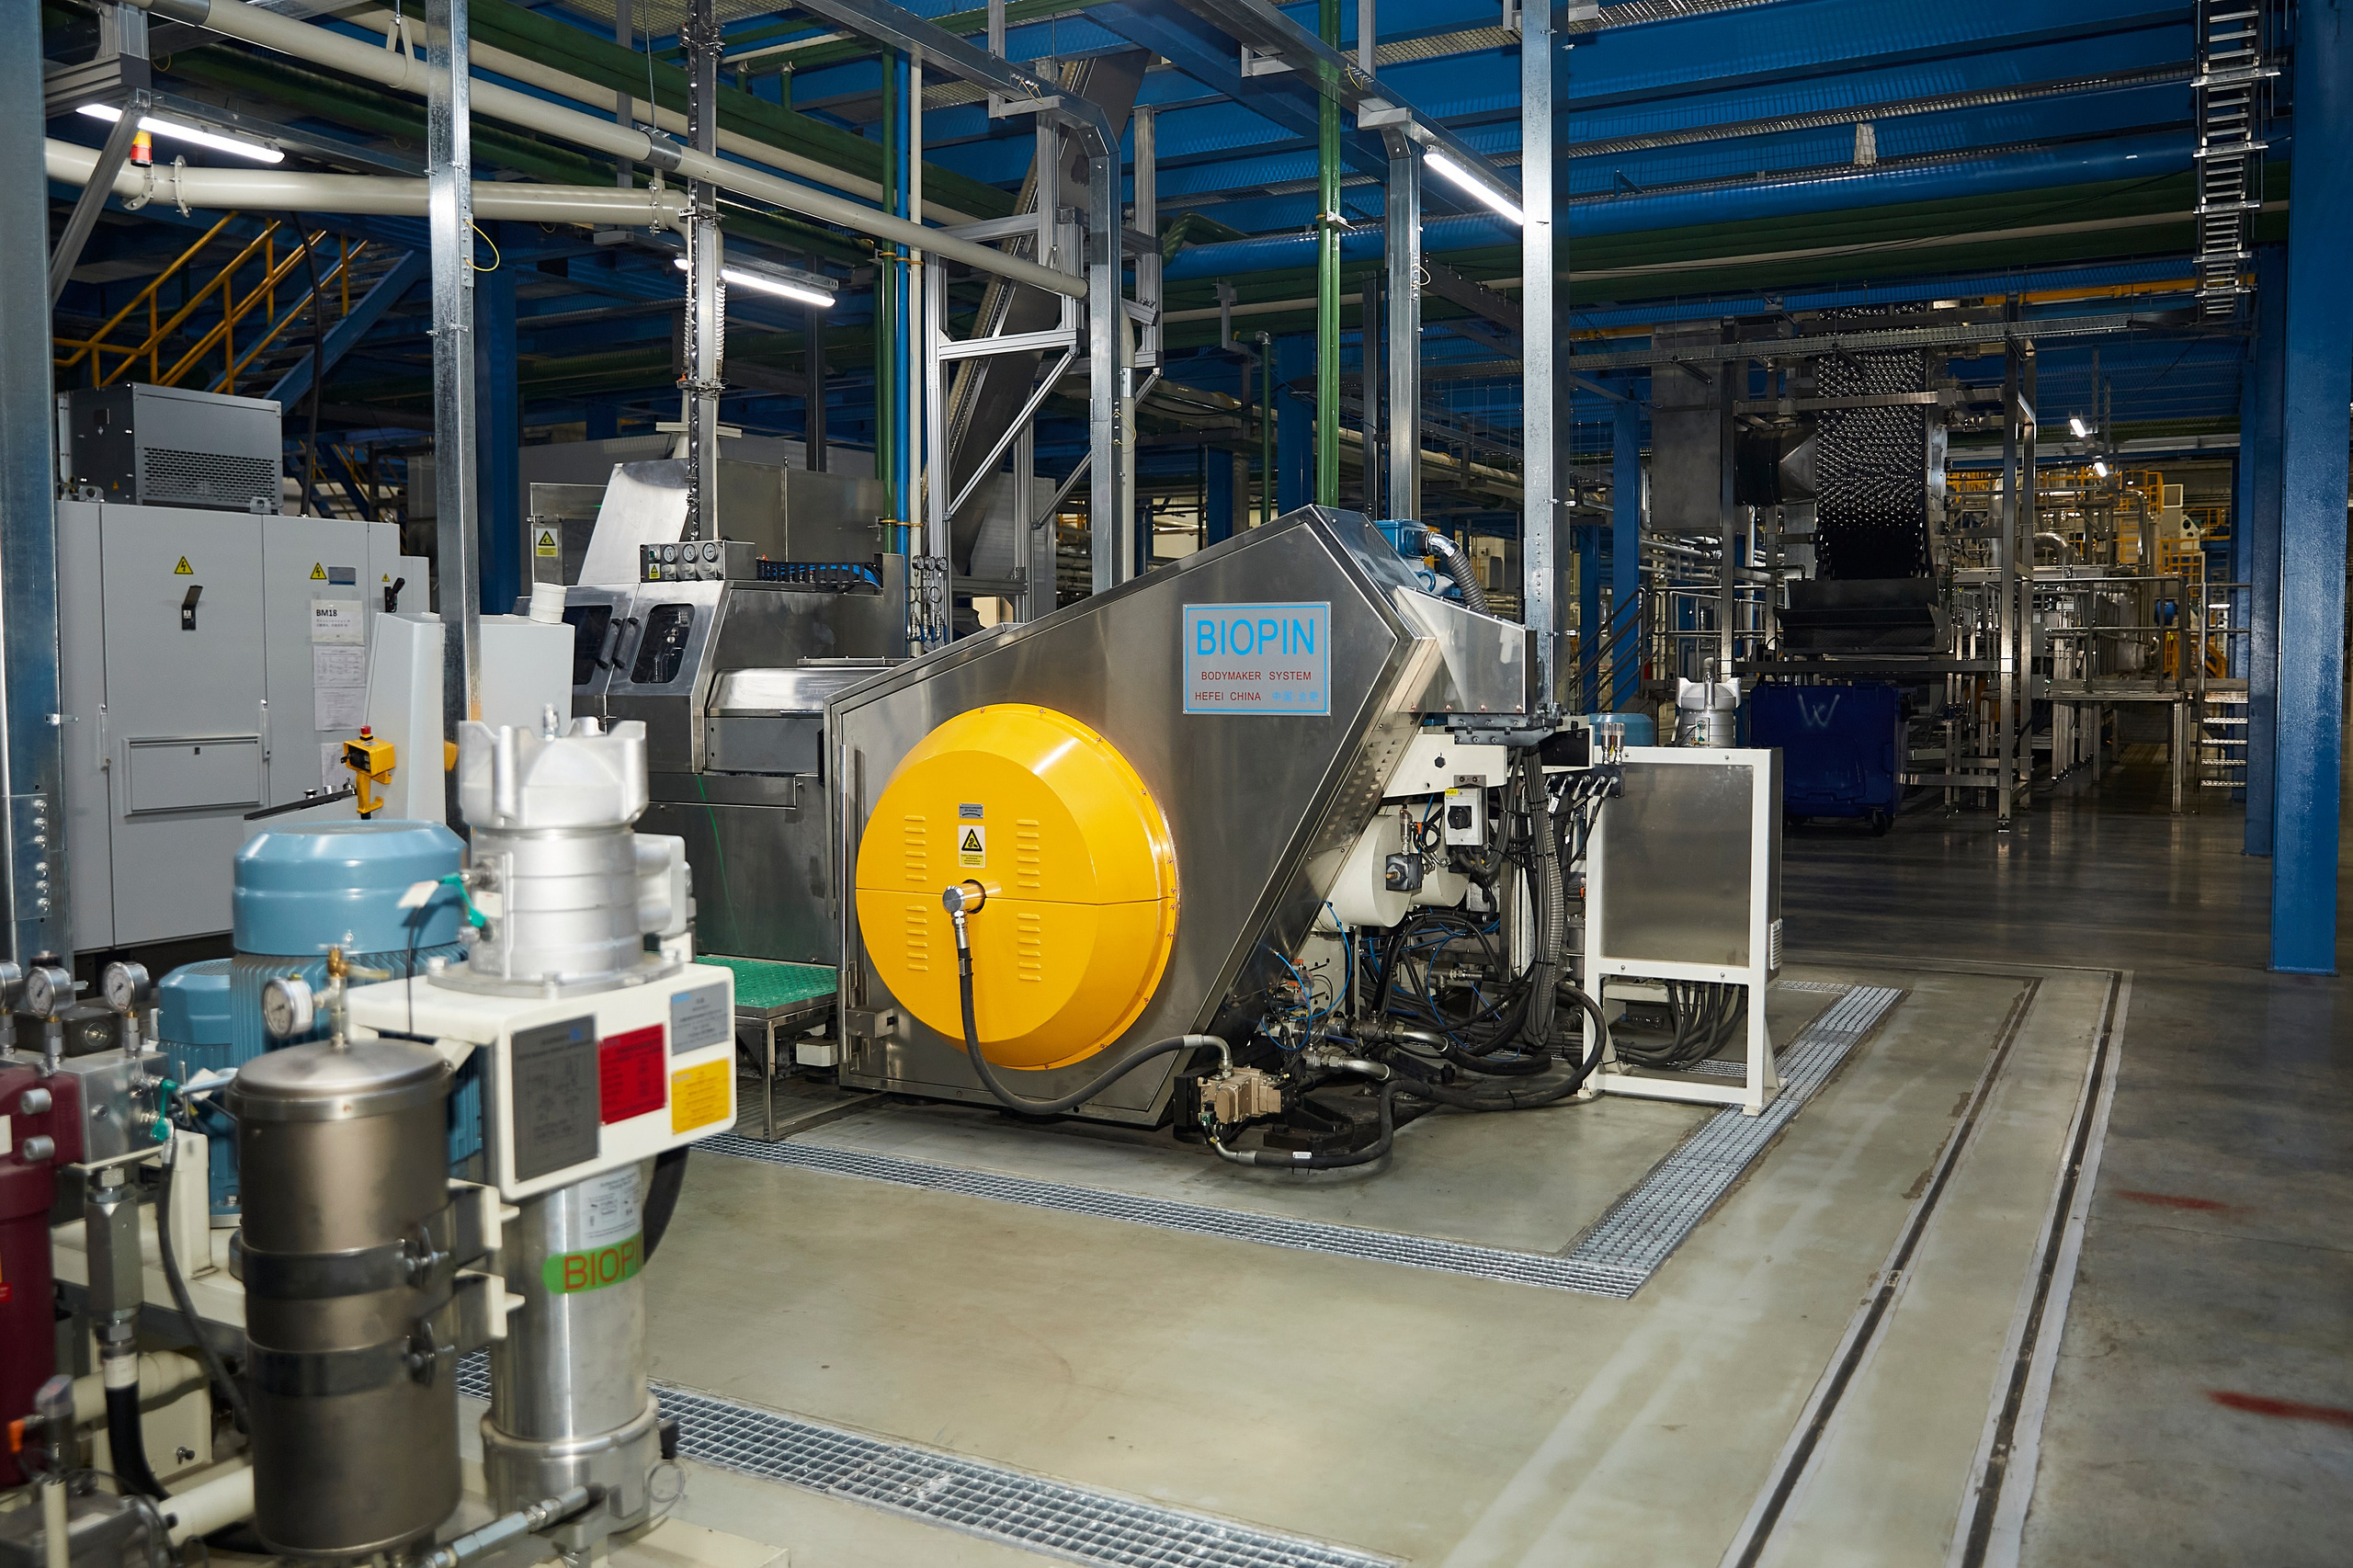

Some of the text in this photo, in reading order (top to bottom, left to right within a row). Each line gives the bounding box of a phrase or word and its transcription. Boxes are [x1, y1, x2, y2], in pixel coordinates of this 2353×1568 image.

[1197, 619, 1314, 655] BIOPIN
[1201, 671, 1312, 680] BODYMAKER SYSTEM
[1195, 691, 1262, 701] HEFEI CHINA
